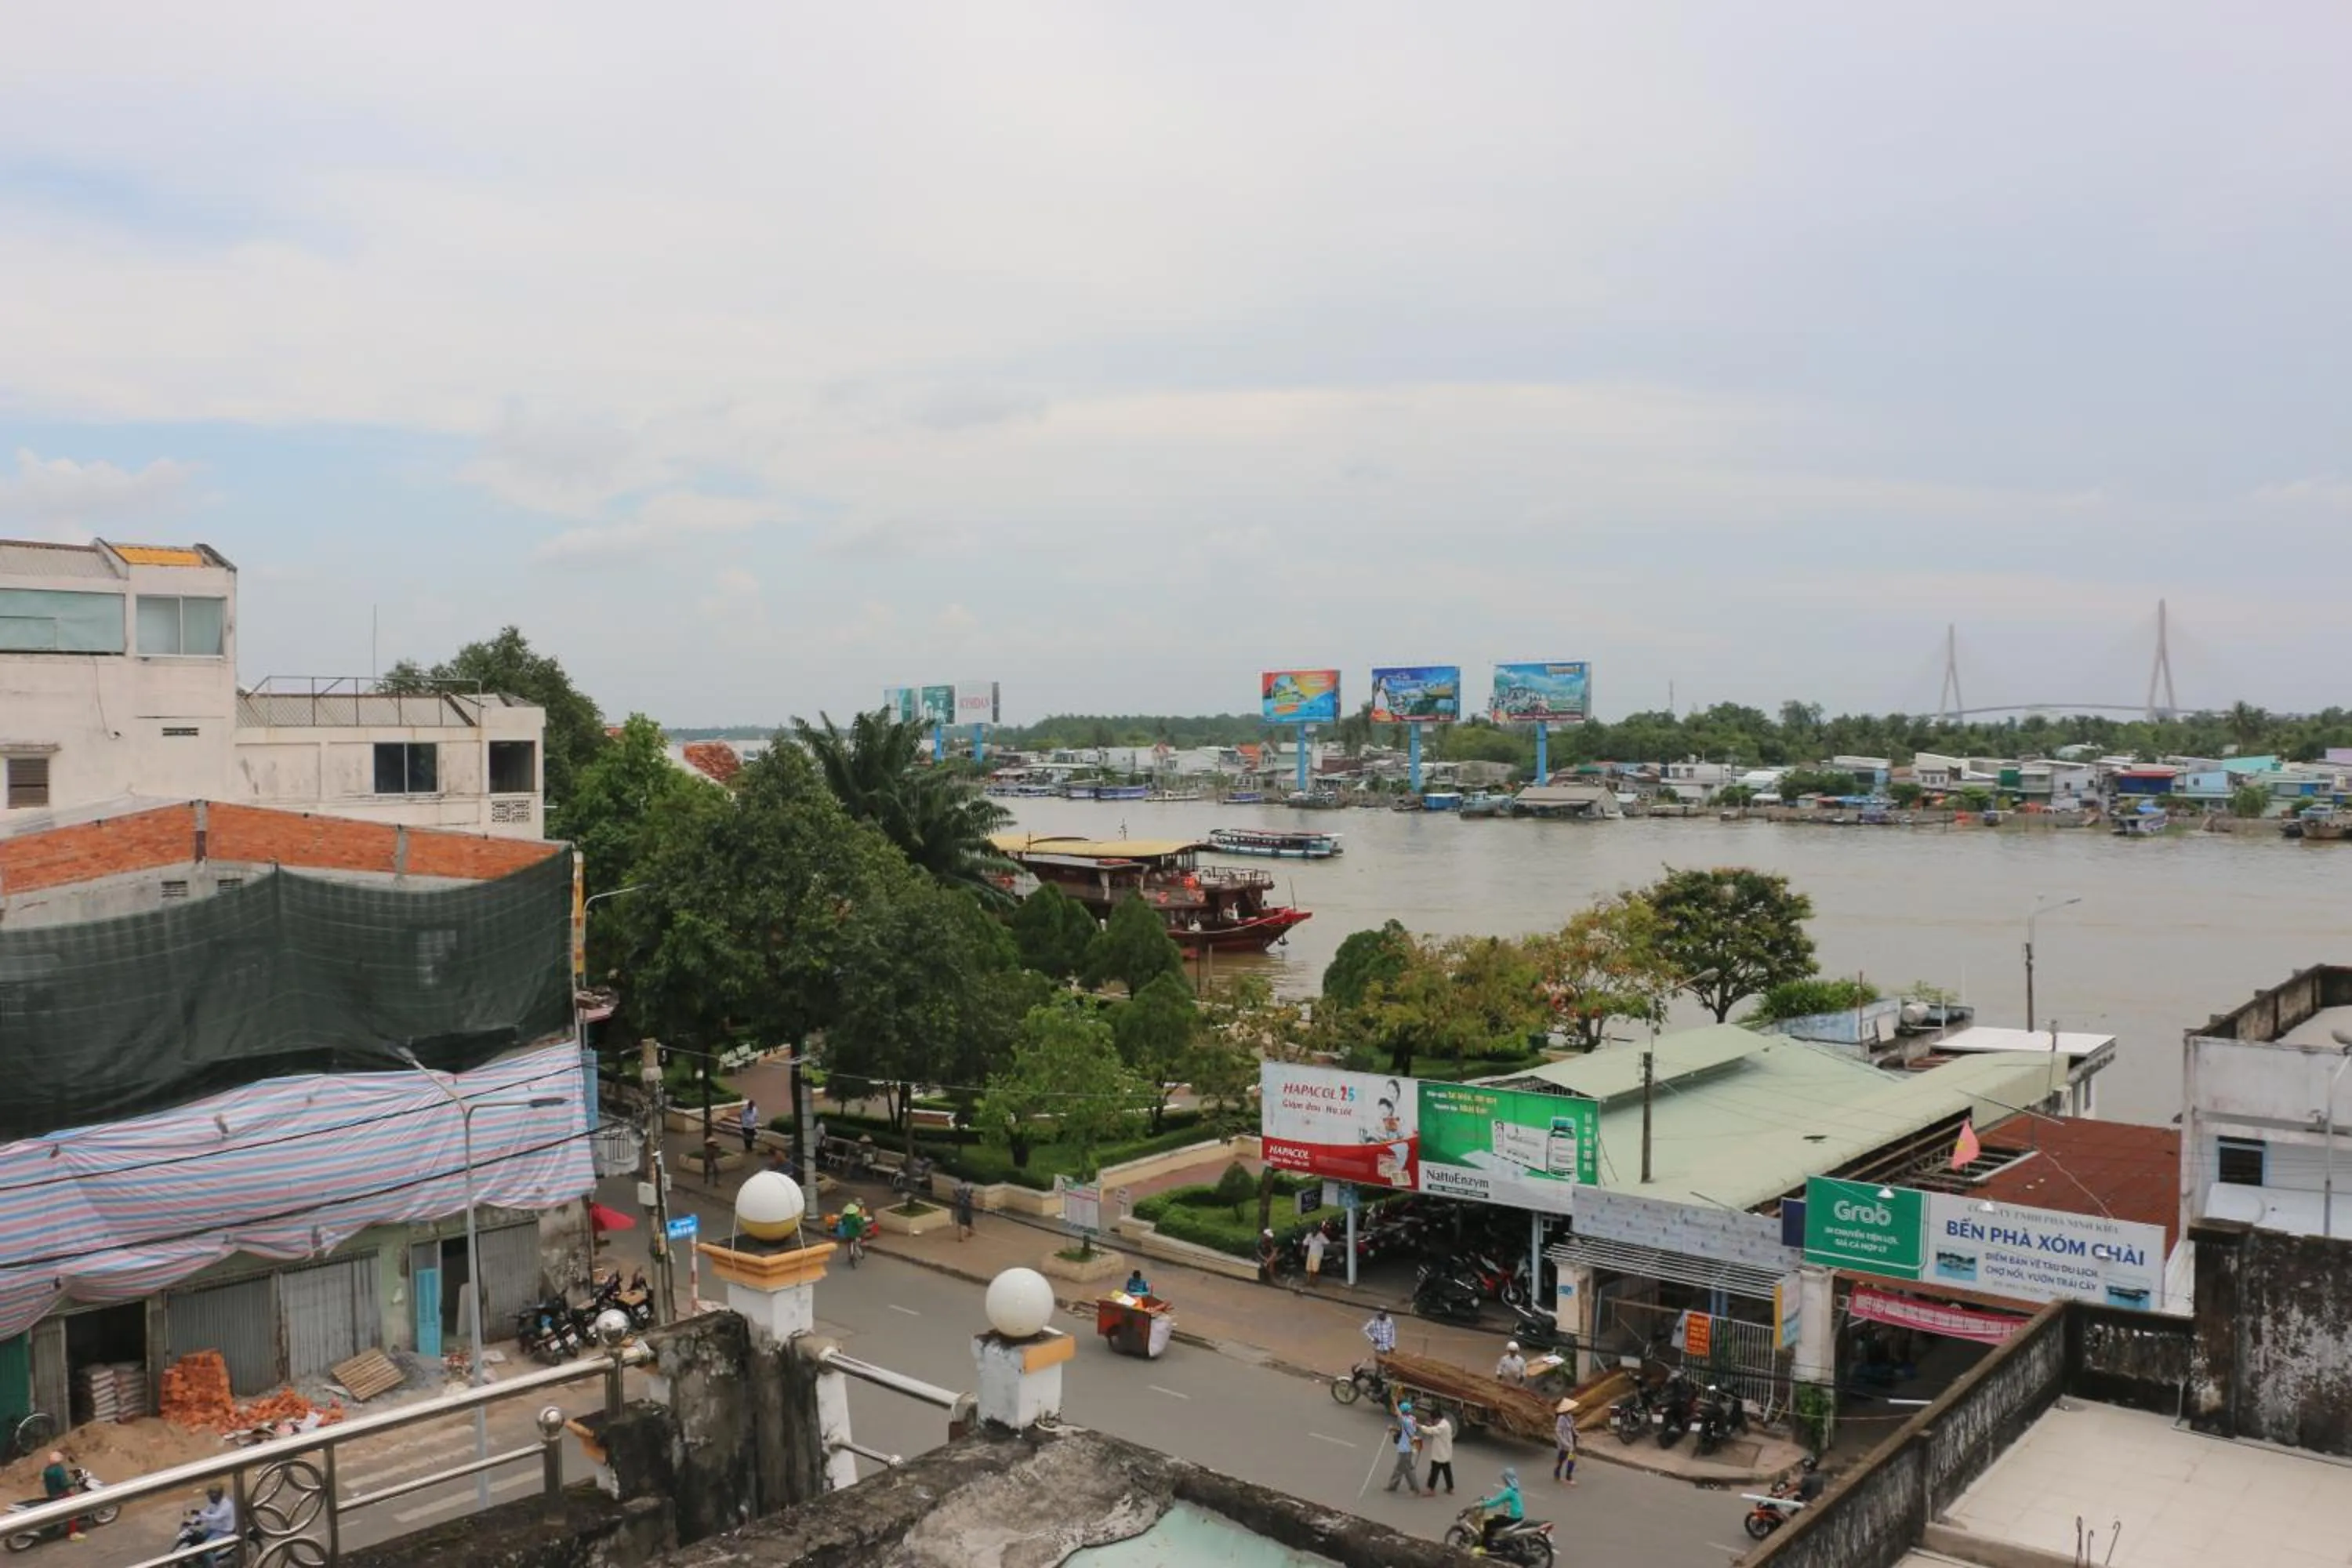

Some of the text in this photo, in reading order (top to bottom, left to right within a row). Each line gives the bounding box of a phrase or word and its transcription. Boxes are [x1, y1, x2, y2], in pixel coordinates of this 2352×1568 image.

[1269, 1145, 1311, 1159] HAPACOL
[1426, 1169, 1489, 1189] NattoEnzym
[1834, 1200, 1892, 1226] Grab
[1946, 1217, 2144, 1266] BẾN PHÀ XÓM CHÀI
[1985, 1251, 2007, 1263] ĐIỂM
[2009, 1254, 2027, 1266] BÁN
[2061, 1264, 2074, 1274] DU
[2077, 1266, 2098, 1278] LỊCH
[1985, 1265, 2005, 1276] CHỢ
[2056, 1276, 2077, 1288] TRÁI
[2078, 1280, 2097, 1290] CÂY
